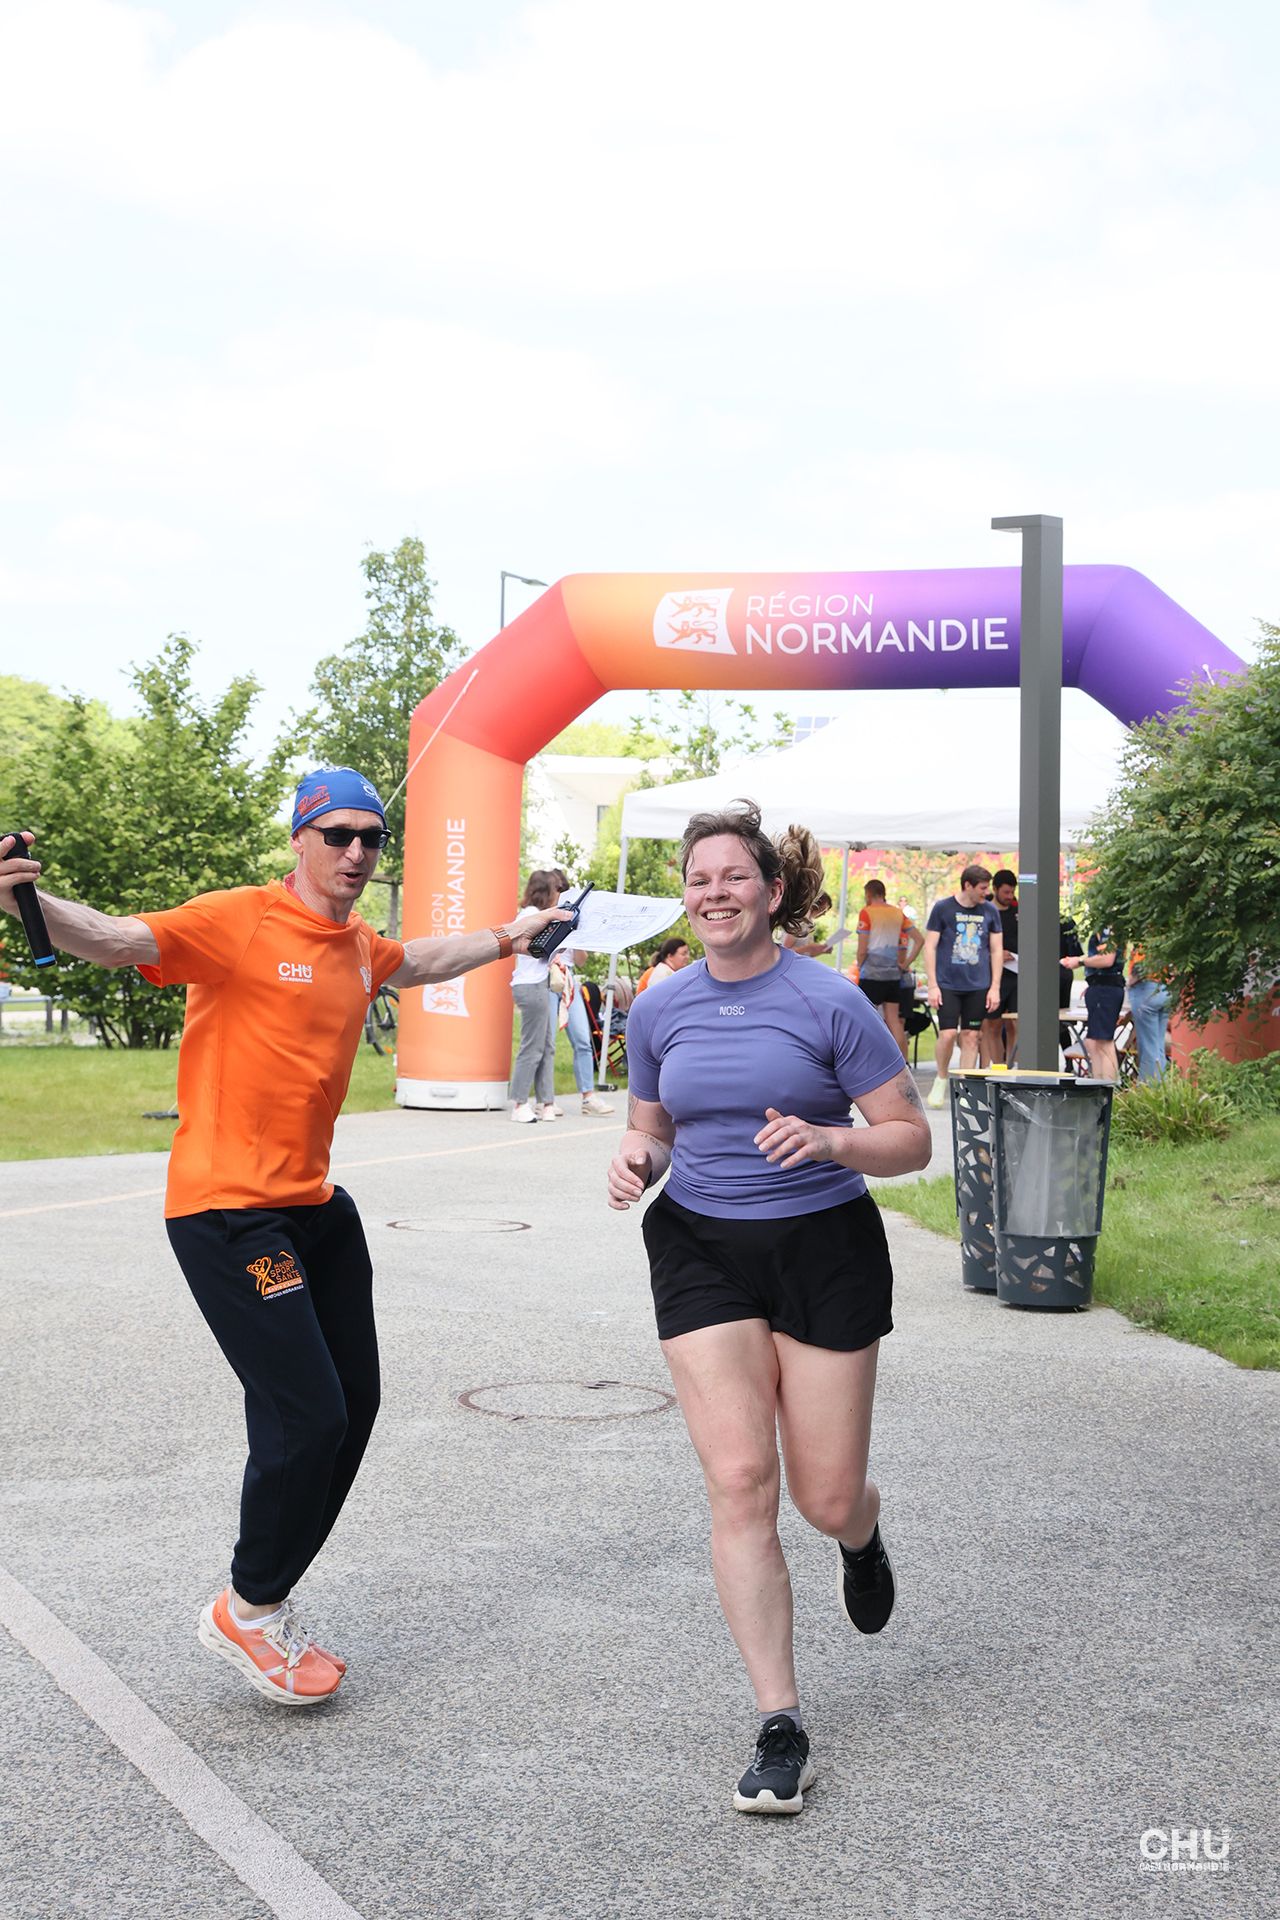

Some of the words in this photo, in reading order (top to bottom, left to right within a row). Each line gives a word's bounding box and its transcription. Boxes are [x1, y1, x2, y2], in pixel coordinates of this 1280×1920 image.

[746, 592, 874, 617] RÉGION
[746, 618, 1009, 655] NORMANDIE
[447, 818, 465, 938] RMANDIE
[431, 894, 445, 939] GION
[278, 962, 312, 978] CHU
[720, 1006, 745, 1016] NOSC
[270, 1264, 294, 1278] SPORT
